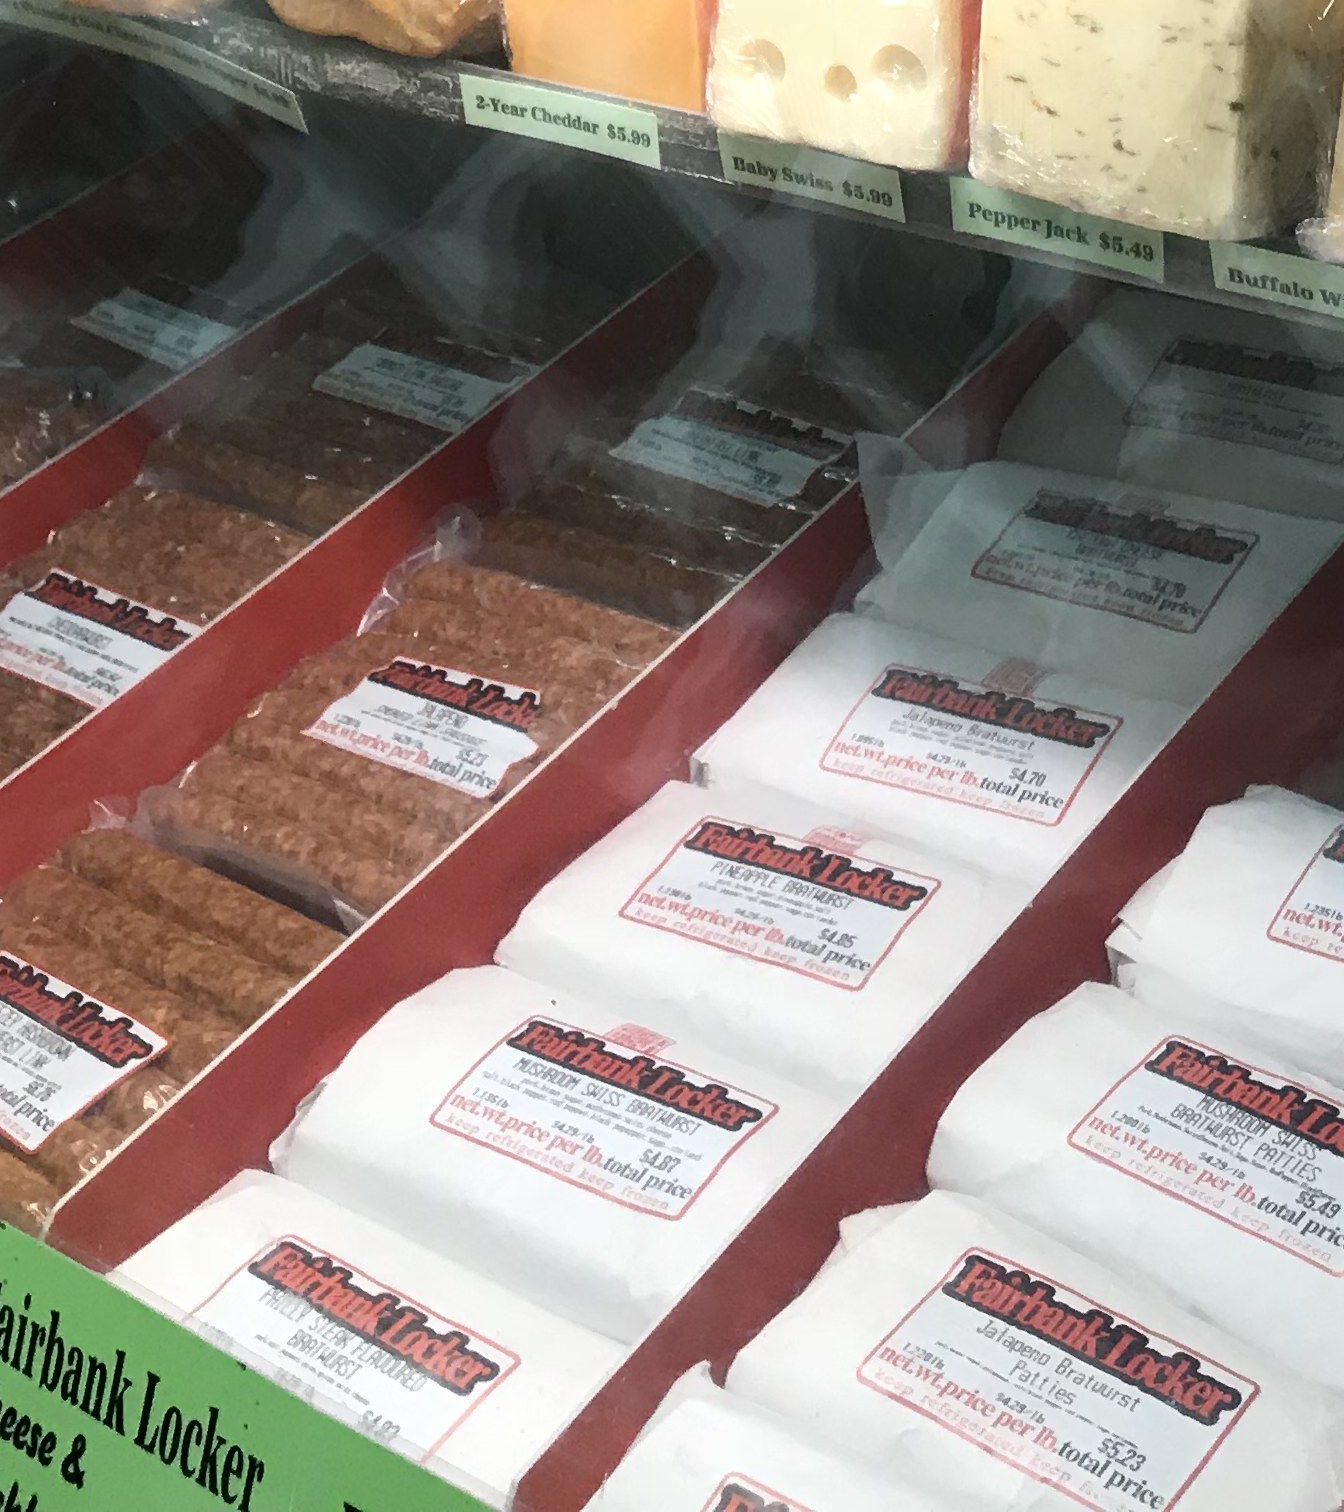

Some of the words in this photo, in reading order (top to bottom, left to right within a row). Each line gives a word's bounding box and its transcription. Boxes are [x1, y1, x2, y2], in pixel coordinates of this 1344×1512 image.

[475, 94, 528, 119] 2-Year
[531, 105, 600, 136] Cheddar
[607, 124, 651, 148] $5.99
[732, 155, 778, 182] Baby
[781, 169, 834, 192] Swiss
[842, 180, 894, 208] $5.99
[967, 202, 1041, 236] Pepper
[1041, 218, 1091, 249] Jack
[1098, 231, 1155, 263] $5.49
[1227, 266, 1315, 303] Buffalo
[512, 1057, 582, 1097] MUSHROOM
[582, 1083, 626, 1108] SWISS
[1146, 1042, 1306, 1124] Fairbank
[1170, 1103, 1250, 1152] BRATWURST
[1254, 1142, 1322, 1183] PATTIES
[976, 1318, 1052, 1365] Jalapeno
[1008, 1357, 1076, 1406] Patties
[61, 1433, 86, 1488] &
[134, 1370, 266, 1512] Locker
